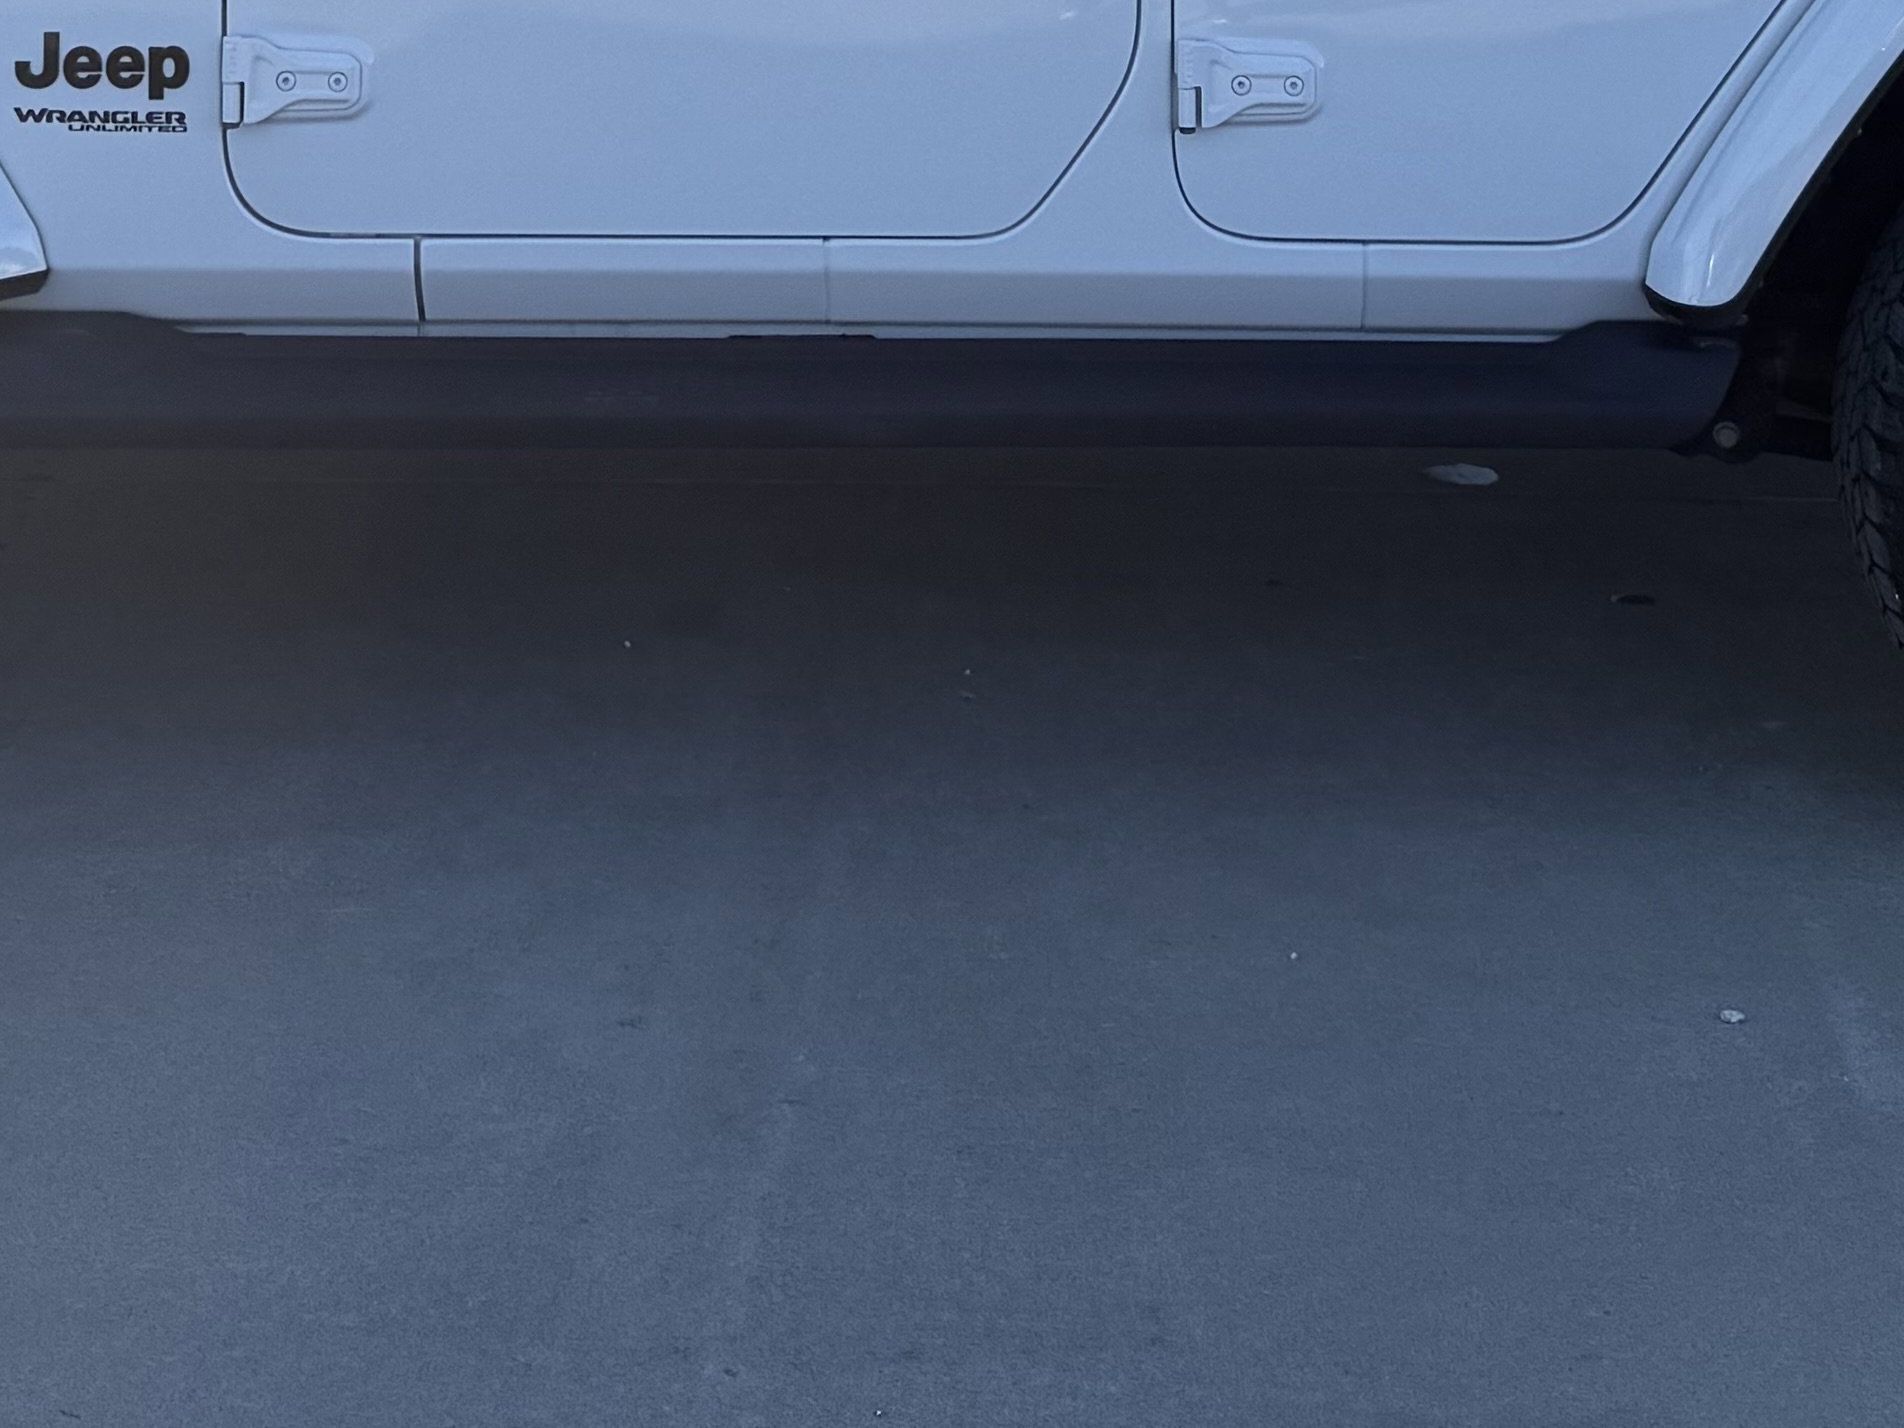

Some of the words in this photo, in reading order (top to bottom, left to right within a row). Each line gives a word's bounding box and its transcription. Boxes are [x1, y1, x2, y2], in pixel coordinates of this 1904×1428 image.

[14, 31, 190, 101] Jeep
[13, 107, 188, 126] WRANGLER
[67, 124, 188, 133] UNLIMITED
